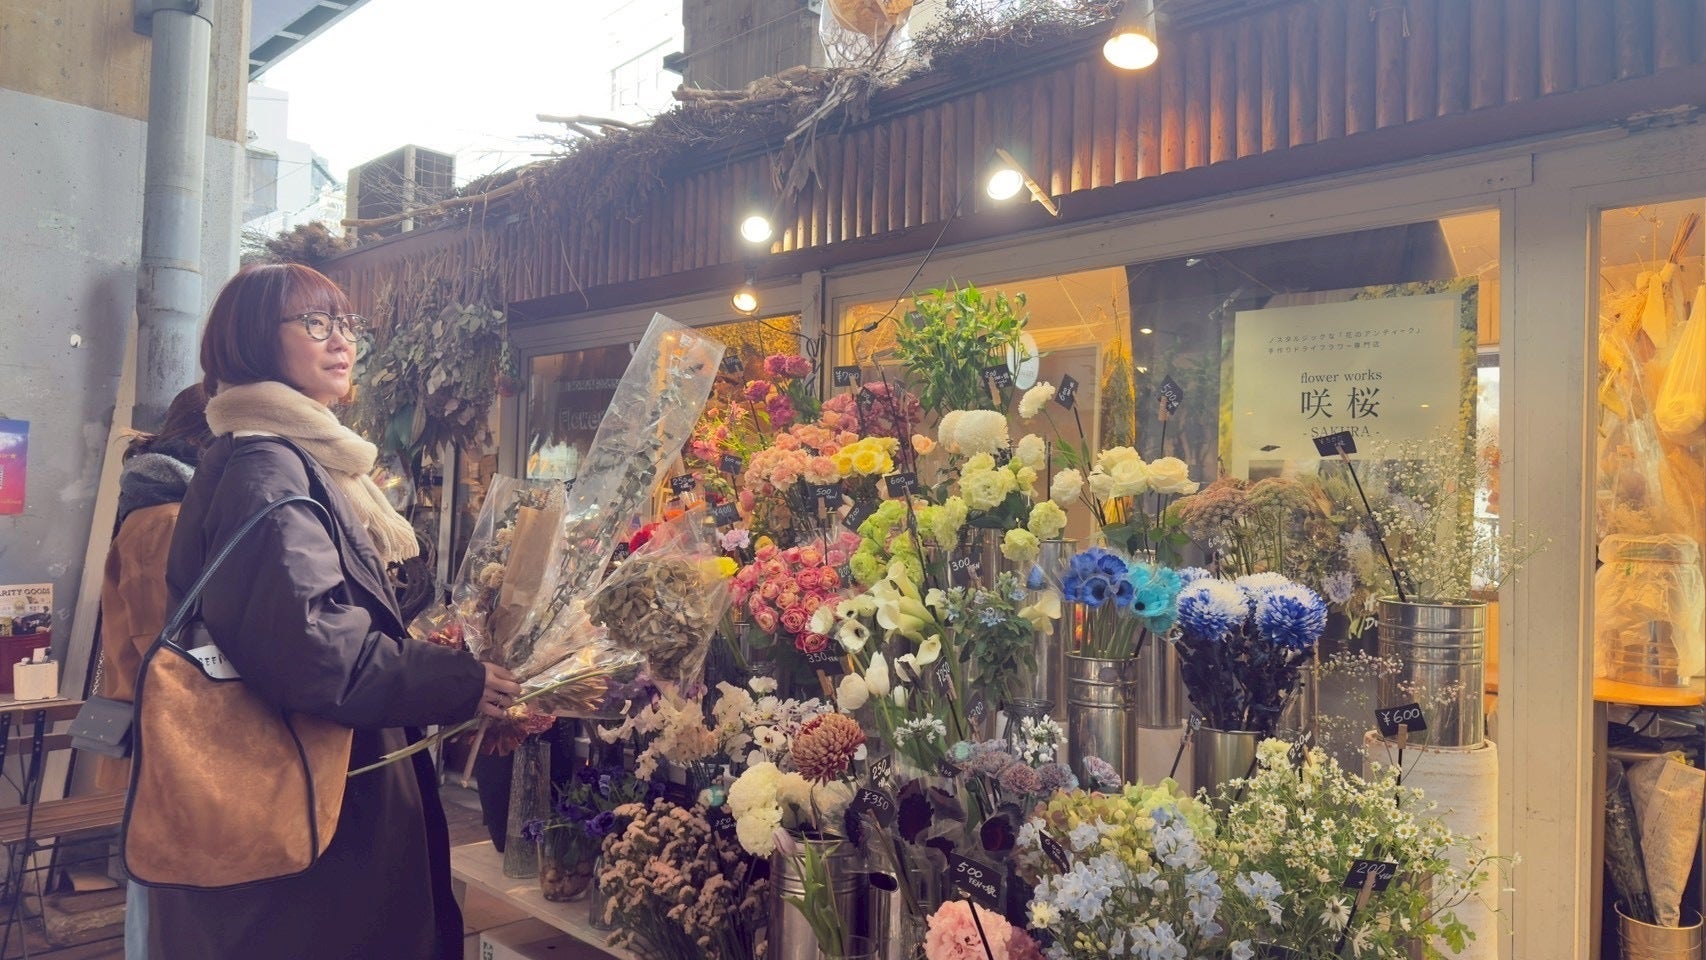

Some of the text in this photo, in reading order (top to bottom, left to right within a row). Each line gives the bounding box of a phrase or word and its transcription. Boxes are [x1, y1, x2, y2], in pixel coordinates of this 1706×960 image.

[1300, 369, 1382, 384] flower works
[890, 476, 906, 485] 600
[816, 487, 832, 496] 500
[951, 556, 971, 572] 300
[806, 652, 828, 663] 350
[1381, 708, 1420, 726] ¥600
[872, 759, 887, 780] 250
[862, 791, 890, 810] ¥350
[956, 862, 983, 879] 500
[1357, 862, 1386, 874] 200
